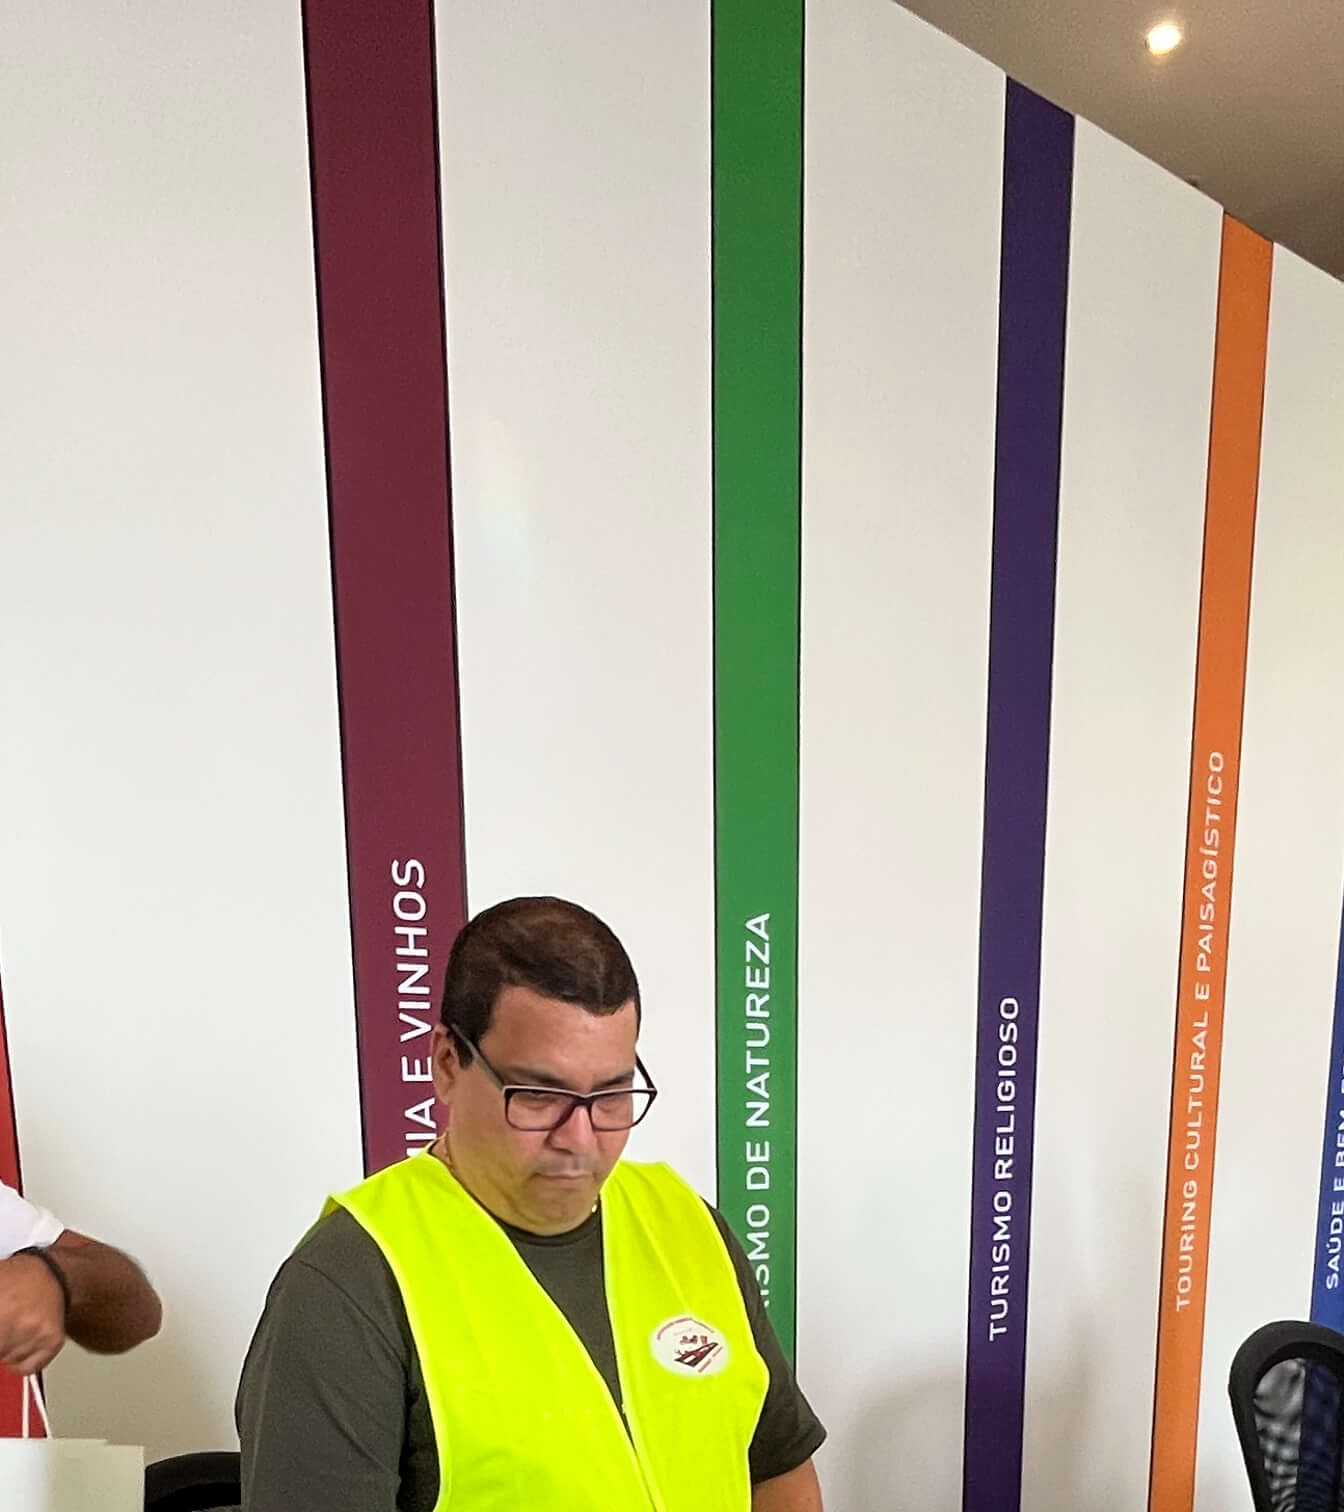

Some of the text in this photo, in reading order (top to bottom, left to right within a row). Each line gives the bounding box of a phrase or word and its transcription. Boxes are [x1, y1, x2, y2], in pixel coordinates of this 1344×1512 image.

[391, 858, 432, 1043] VINHOS
[746, 912, 771, 1128] NATUREZA
[1175, 751, 1224, 1312] TOURING CULTURAL E PAISAGÍSTICO
[401, 1056, 433, 1082] E
[746, 1141, 771, 1191] DE
[988, 996, 1019, 1342] TURISMO RELIGIOSO
[1326, 1201, 1344, 1290] SAÚDE
